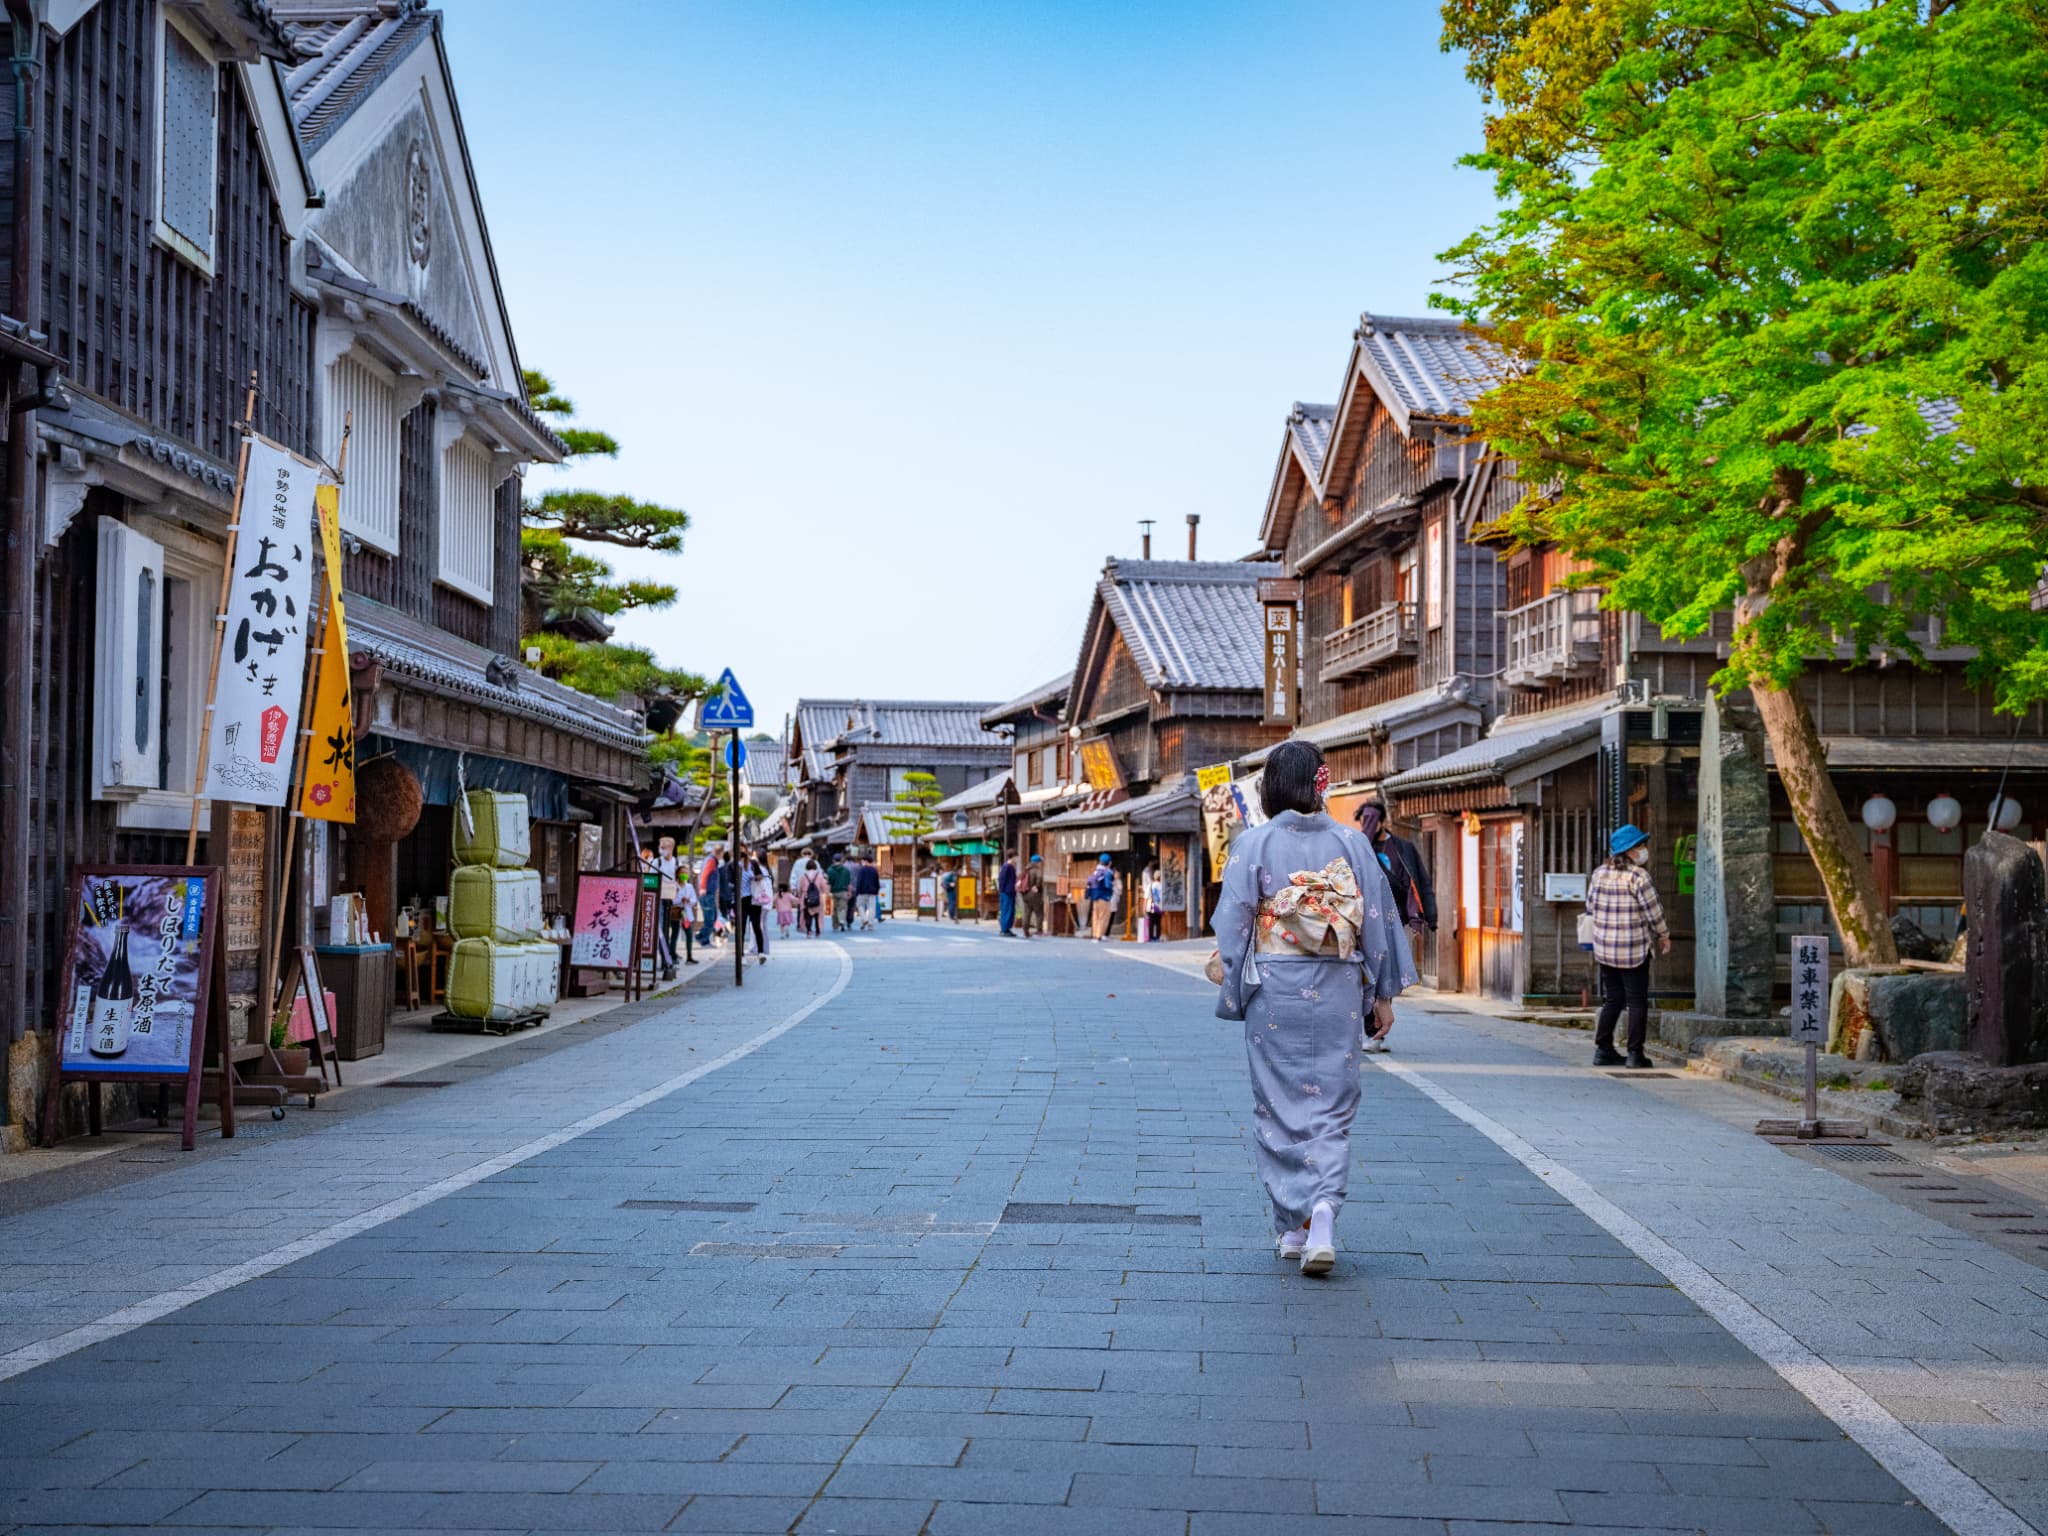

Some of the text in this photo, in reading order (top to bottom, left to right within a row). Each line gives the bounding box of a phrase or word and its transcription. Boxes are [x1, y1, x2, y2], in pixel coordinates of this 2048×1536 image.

[272, 468, 290, 530] 伊勢の地酒
[234, 536, 302, 697] おかげさま
[1271, 610, 1288, 628] 薬
[587, 888, 621, 960] 純米花見酒
[133, 973, 157, 1035] 生原酒
[1799, 945, 1821, 1032] 駐車禁止
[99, 1007, 118, 1049] 生原酒
